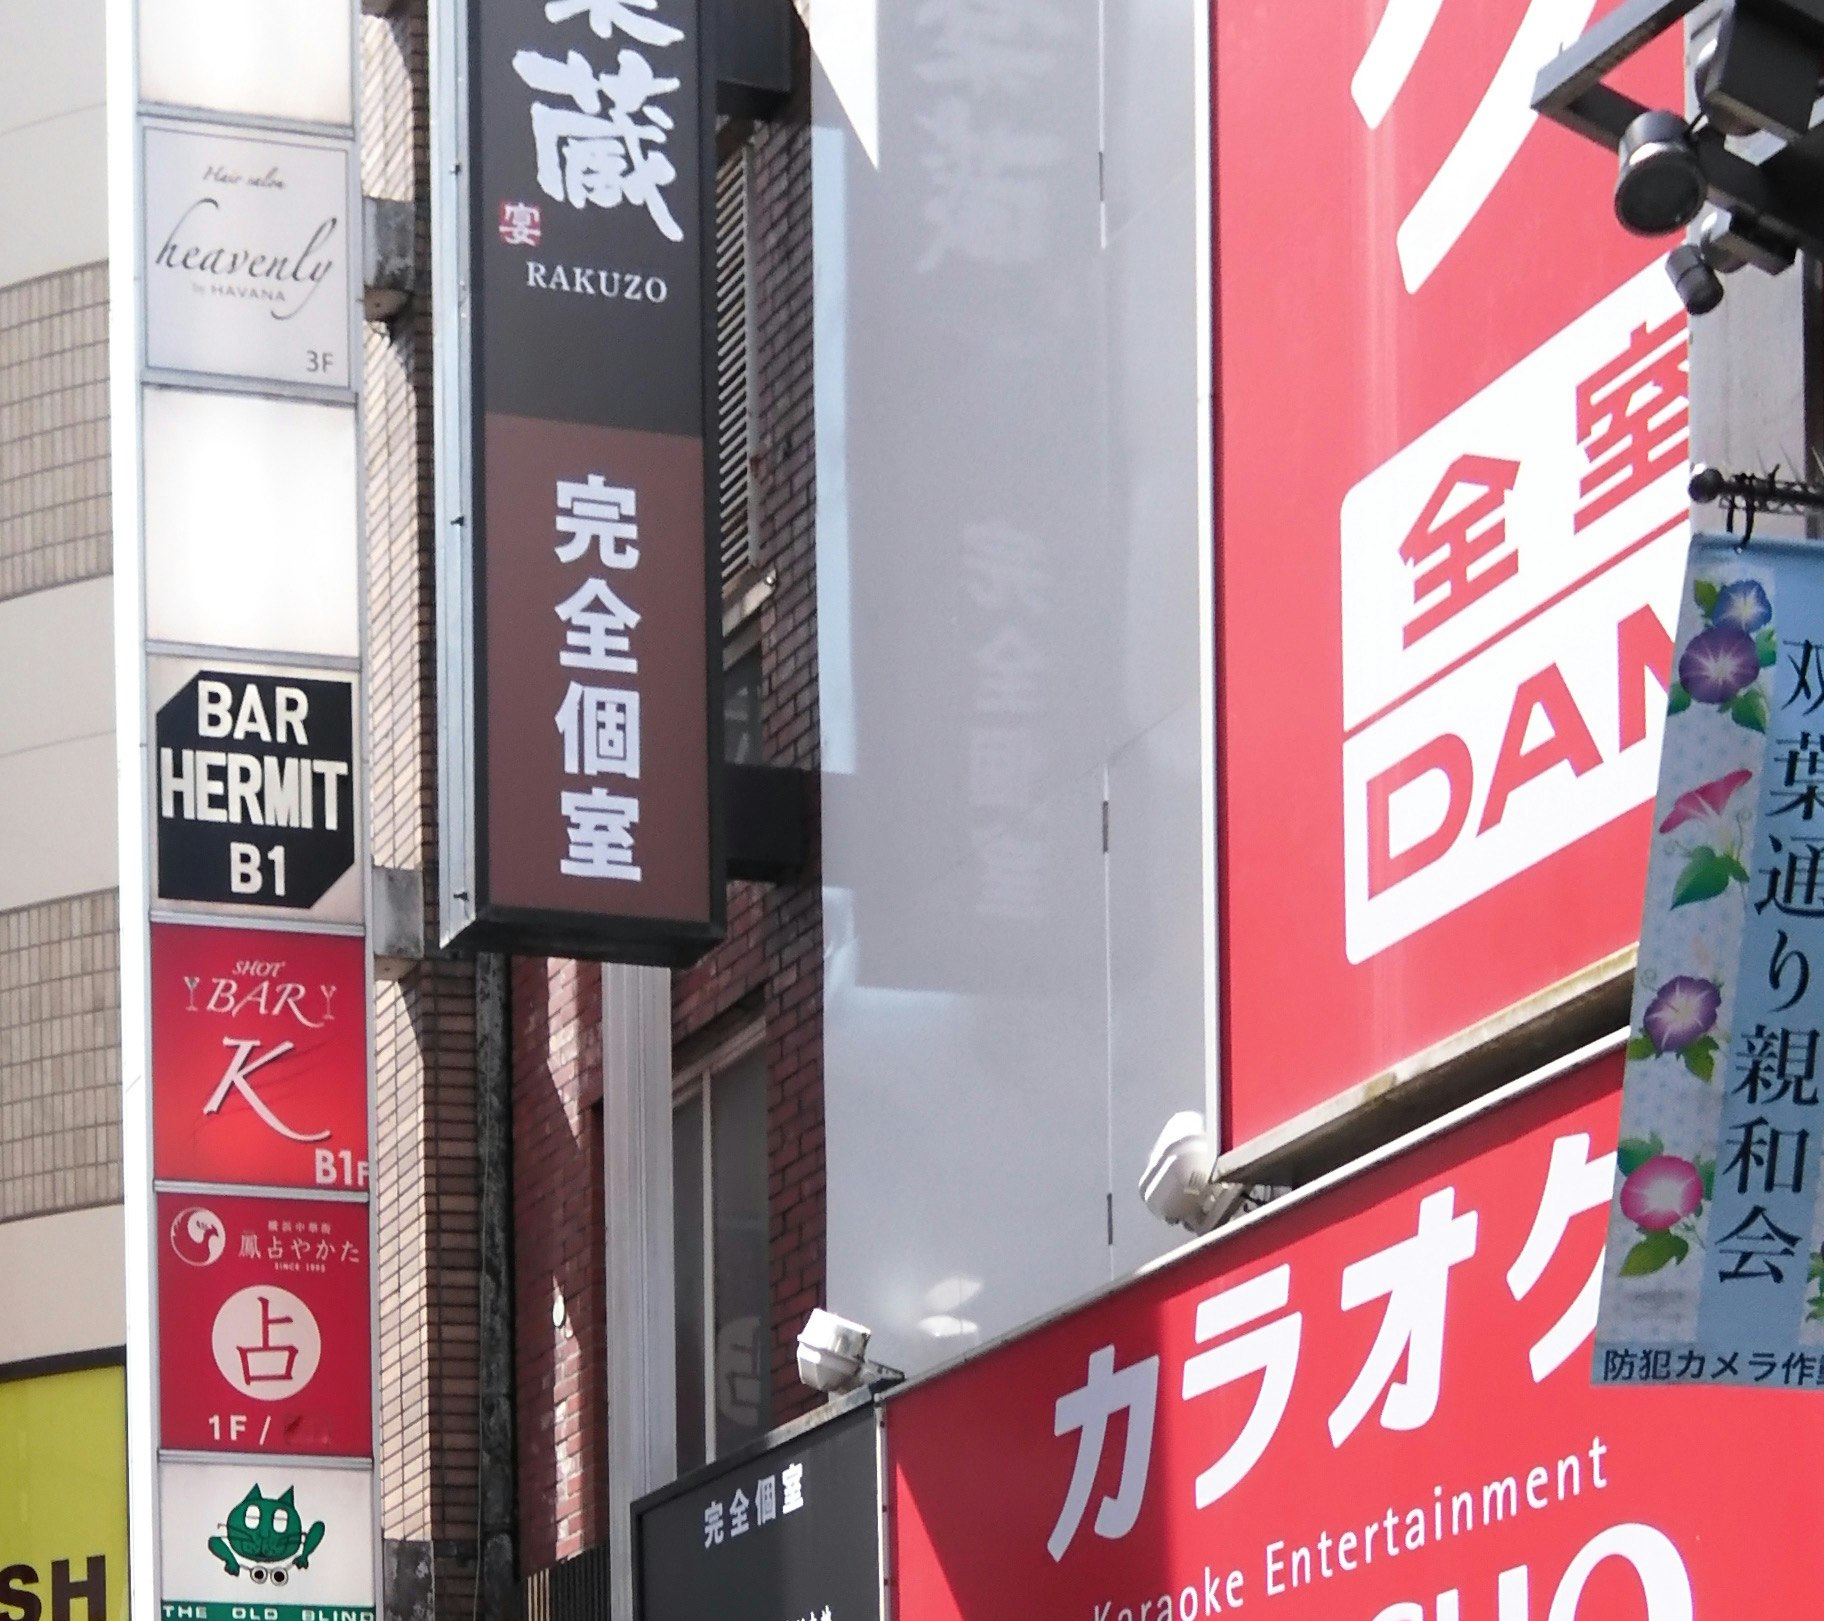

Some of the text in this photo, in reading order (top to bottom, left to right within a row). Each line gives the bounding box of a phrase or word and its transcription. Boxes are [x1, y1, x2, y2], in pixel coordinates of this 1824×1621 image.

[513, 0, 684, 242] 蔵
[155, 197, 338, 321] heavenly
[210, 282, 287, 302] HAVANA
[526, 261, 669, 304] RAKUZO
[306, 350, 335, 373] 3F
[198, 681, 308, 746] BAR
[554, 474, 643, 883] 完全個室
[159, 748, 348, 832] HERMIT
[230, 844, 287, 897] B1
[206, 978, 325, 1028] BAR
[232, 960, 286, 977] SHOT
[203, 1036, 331, 1142] K
[236, 1296, 299, 1386] 占
[704, 1462, 804, 1549] 完全個室
[1266, 1436, 1608, 1597] Entertainment
[163, 1606, 207, 1619] THE
[232, 1607, 278, 1621] OLD
